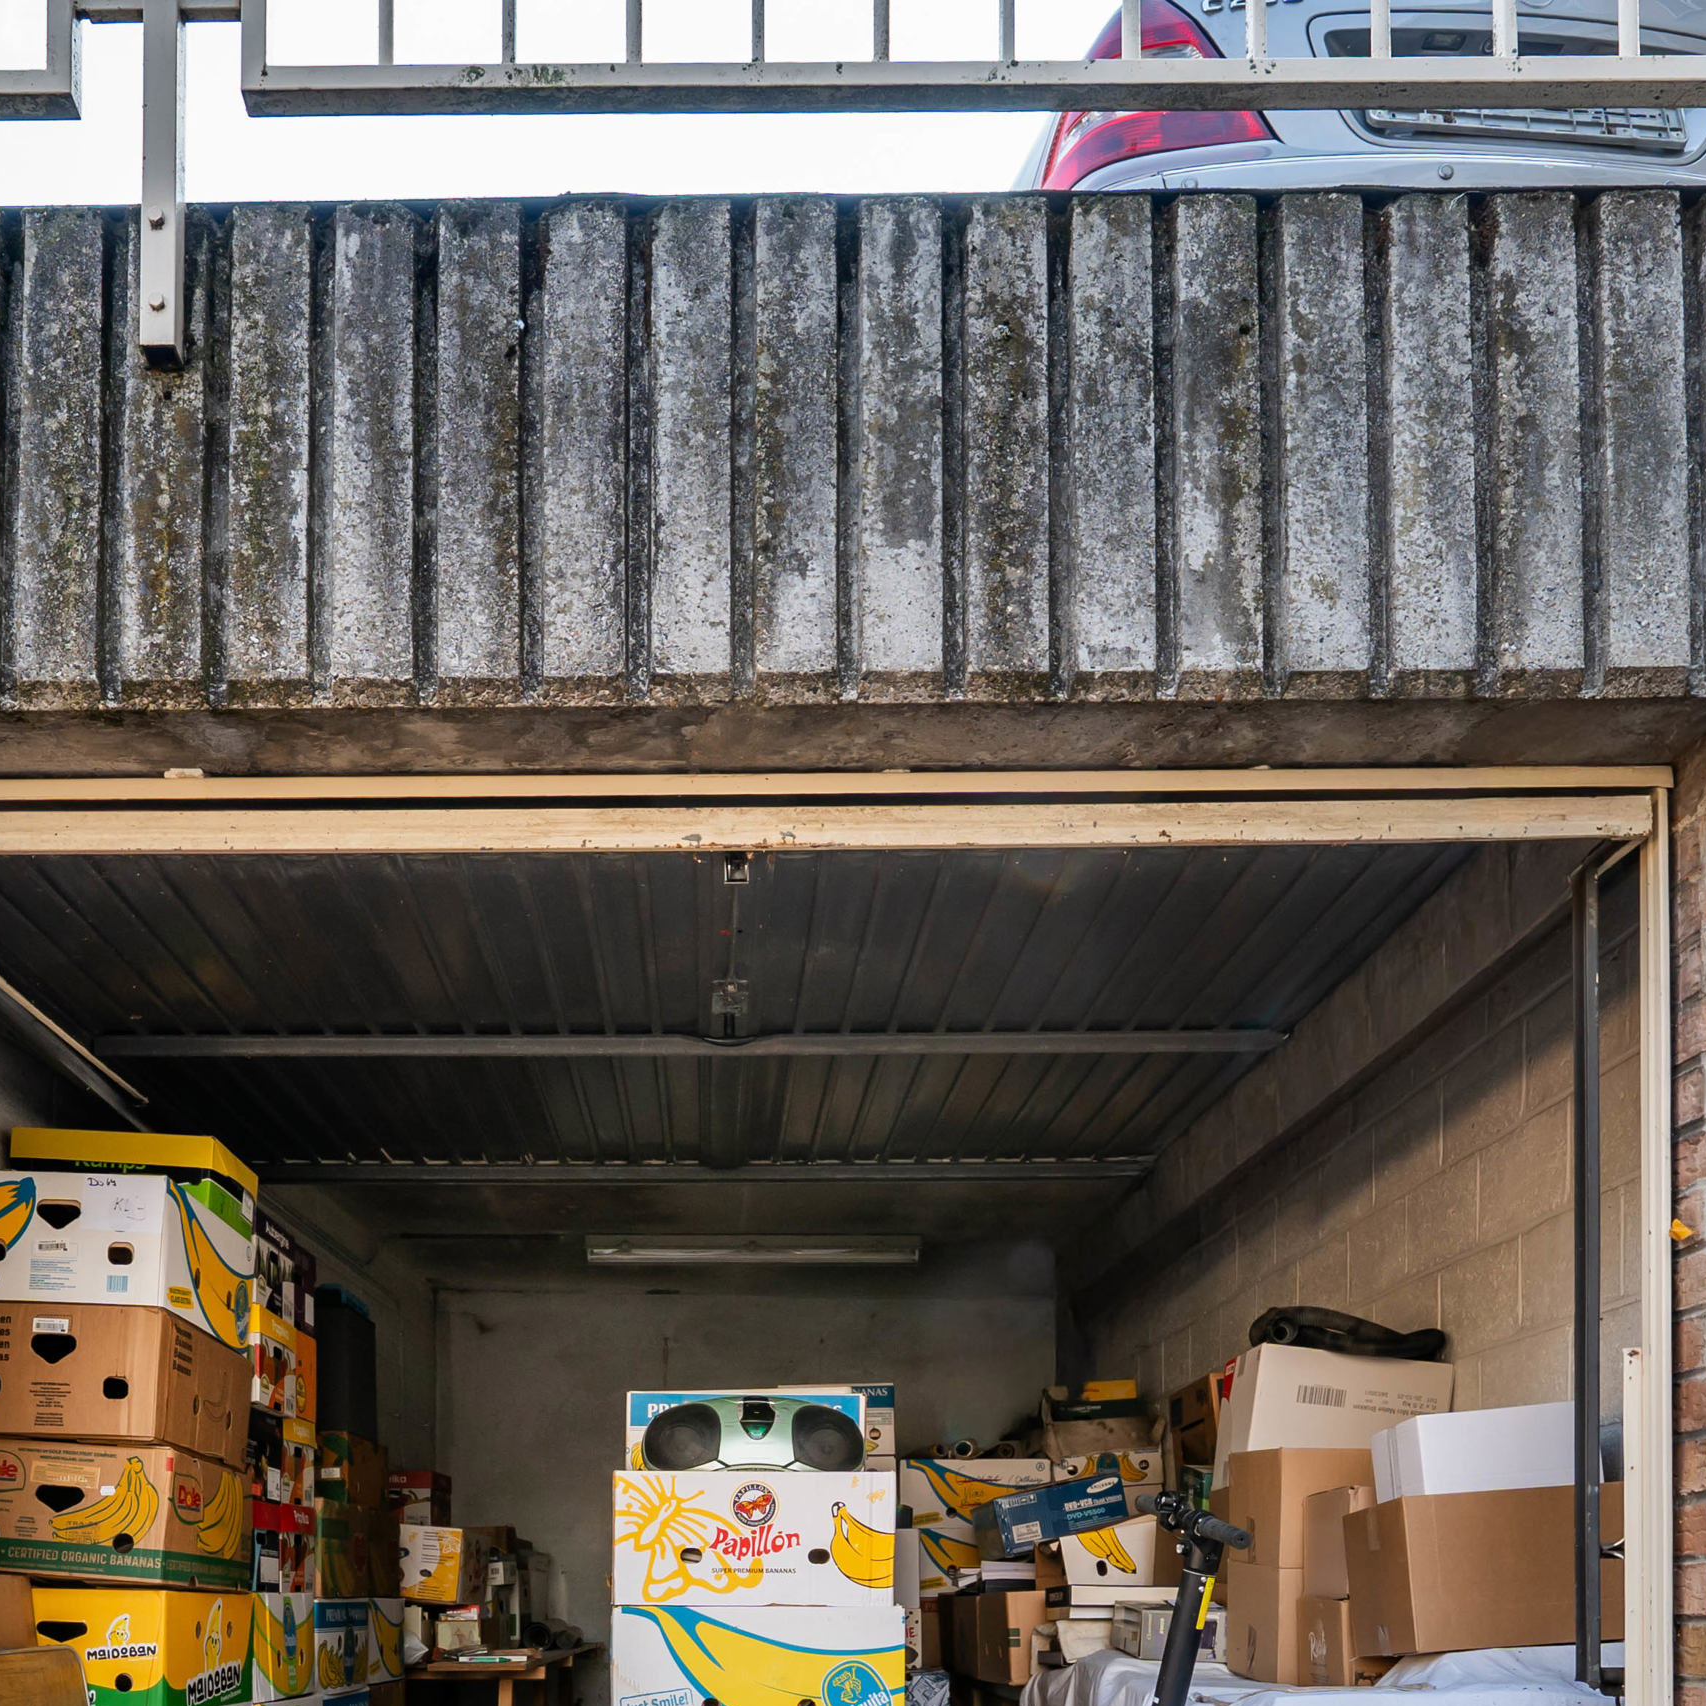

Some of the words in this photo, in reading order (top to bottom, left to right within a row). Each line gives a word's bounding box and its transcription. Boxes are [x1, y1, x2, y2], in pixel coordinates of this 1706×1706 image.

[178, 1485, 202, 1509] Dole
[7, 1546, 59, 1561] CERTIFIED
[61, 1550, 107, 1565] ORGANIC
[109, 1555, 162, 1569] BANANAS
